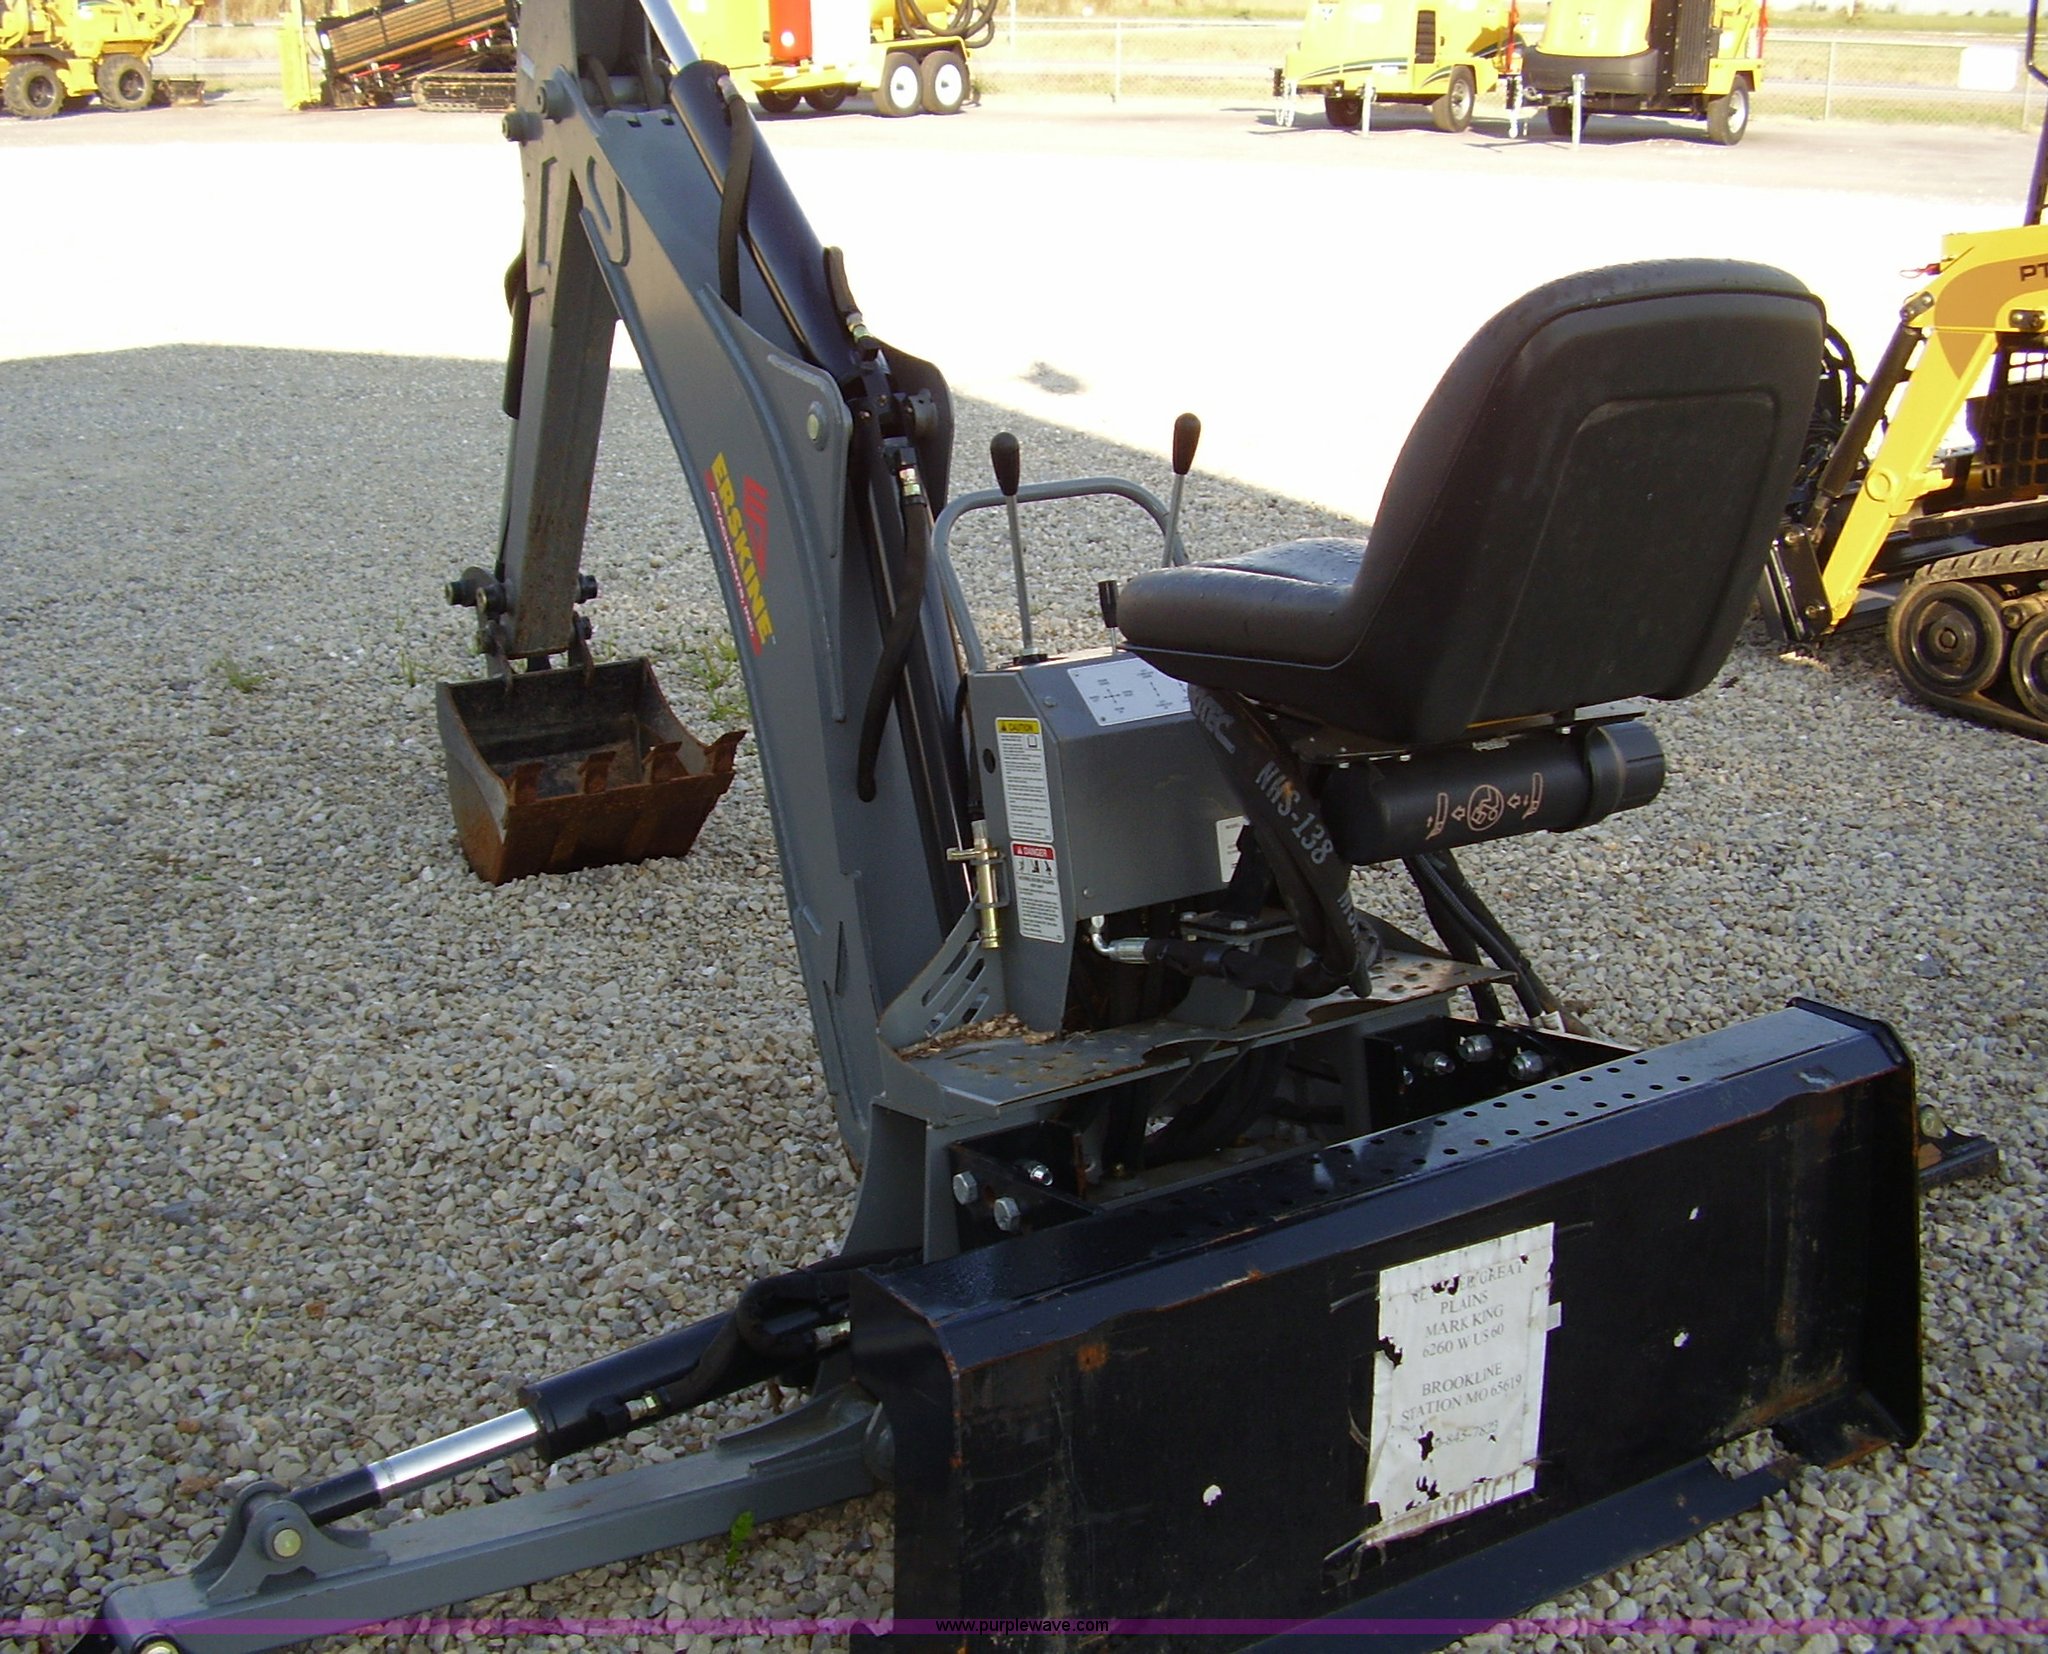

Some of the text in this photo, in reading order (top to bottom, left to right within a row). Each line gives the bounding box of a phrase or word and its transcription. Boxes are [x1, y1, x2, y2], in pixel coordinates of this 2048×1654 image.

[711, 451, 773, 644] ERSKINE
[1008, 723, 1033, 732] CAUTION
[1022, 847, 1047, 857] DANGER
[1480, 1262, 1523, 1284] GREAT
[1440, 1290, 1489, 1315] PLAINS
[1425, 1304, 1504, 1338] MARK KING
[1423, 1323, 1505, 1358] 6260 W US 60
[1422, 1362, 1503, 1396] BROOKLINE
[1401, 1374, 1523, 1422] STATION MO 65619
